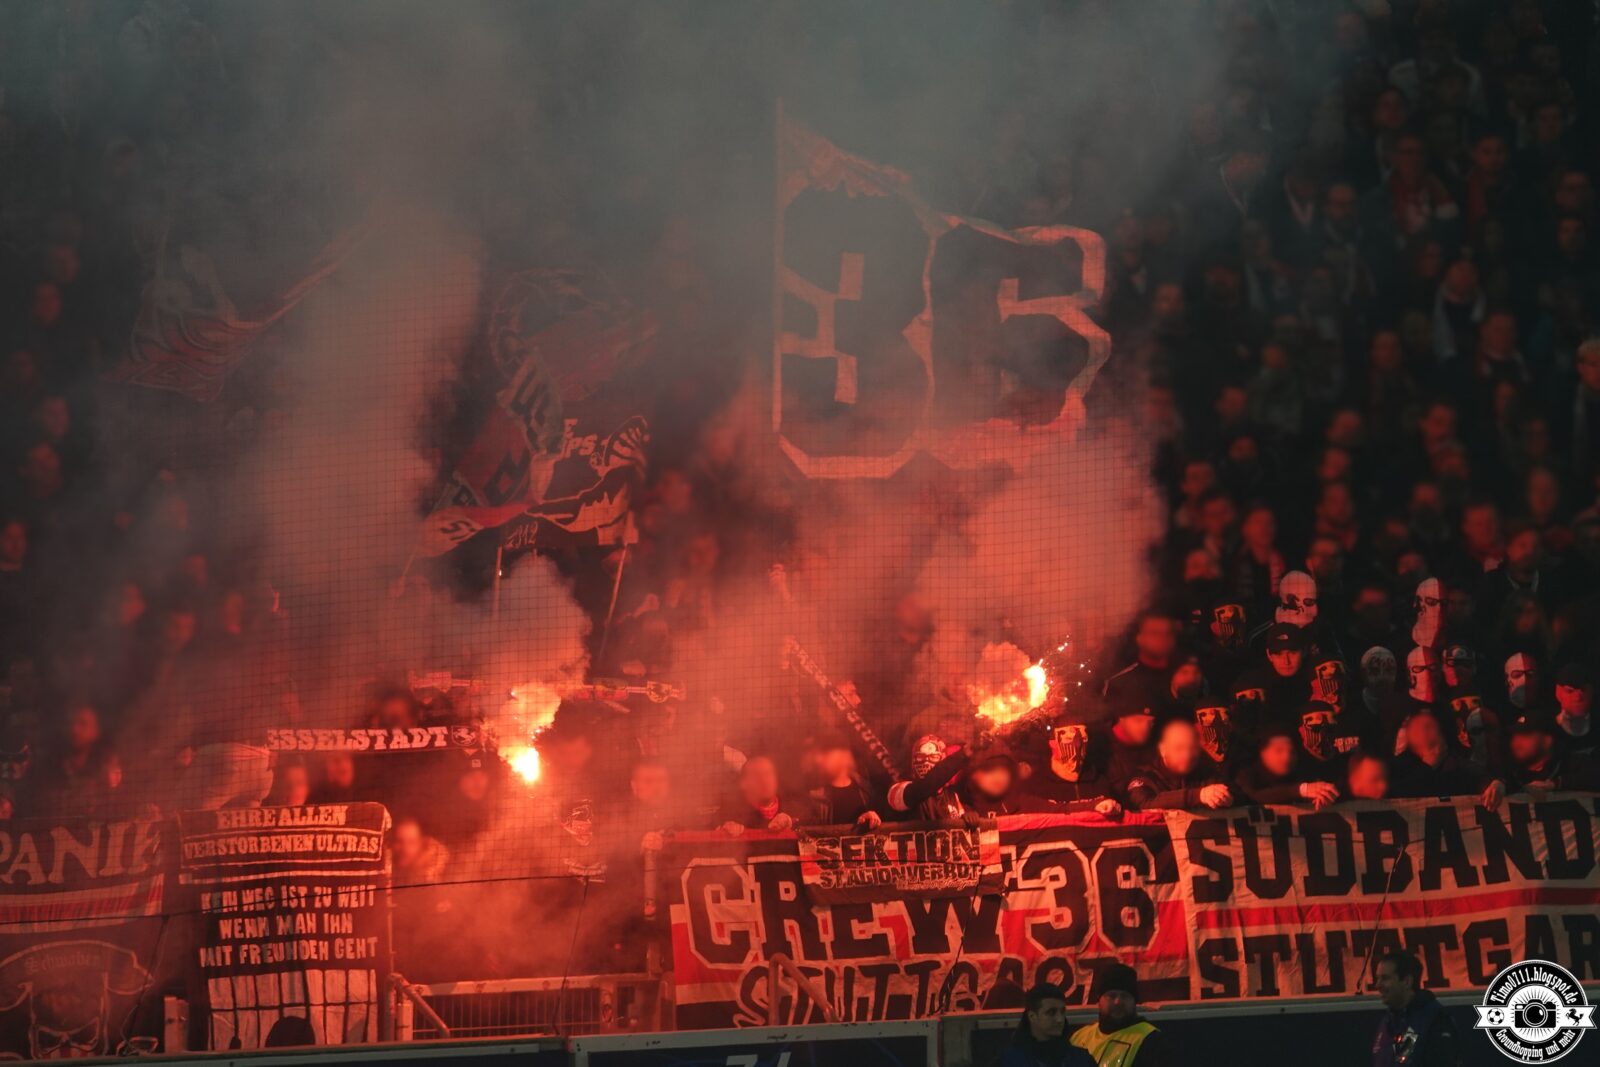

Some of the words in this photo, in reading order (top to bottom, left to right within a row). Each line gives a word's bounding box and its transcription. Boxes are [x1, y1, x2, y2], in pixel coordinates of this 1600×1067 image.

[217, 806, 277, 829] EHRE
[278, 804, 348, 826] ALLEN
[183, 834, 316, 860] VERSTORBENEN
[317, 833, 379, 853] ULTRAS
[816, 828, 981, 870] SEKTION
[1185, 800, 1600, 904] SÜDBAND
[201, 887, 238, 913] KEIN
[242, 886, 275, 910] WEG
[280, 884, 308, 909] IST
[313, 885, 332, 908] ZU
[337, 884, 376, 908] WEIT
[219, 916, 270, 940] WENN
[276, 912, 317, 937] MAN
[323, 911, 353, 934] IHN
[200, 944, 233, 968] MIT
[239, 937, 329, 965] FREUNDEN
[334, 936, 378, 960] GEHT
